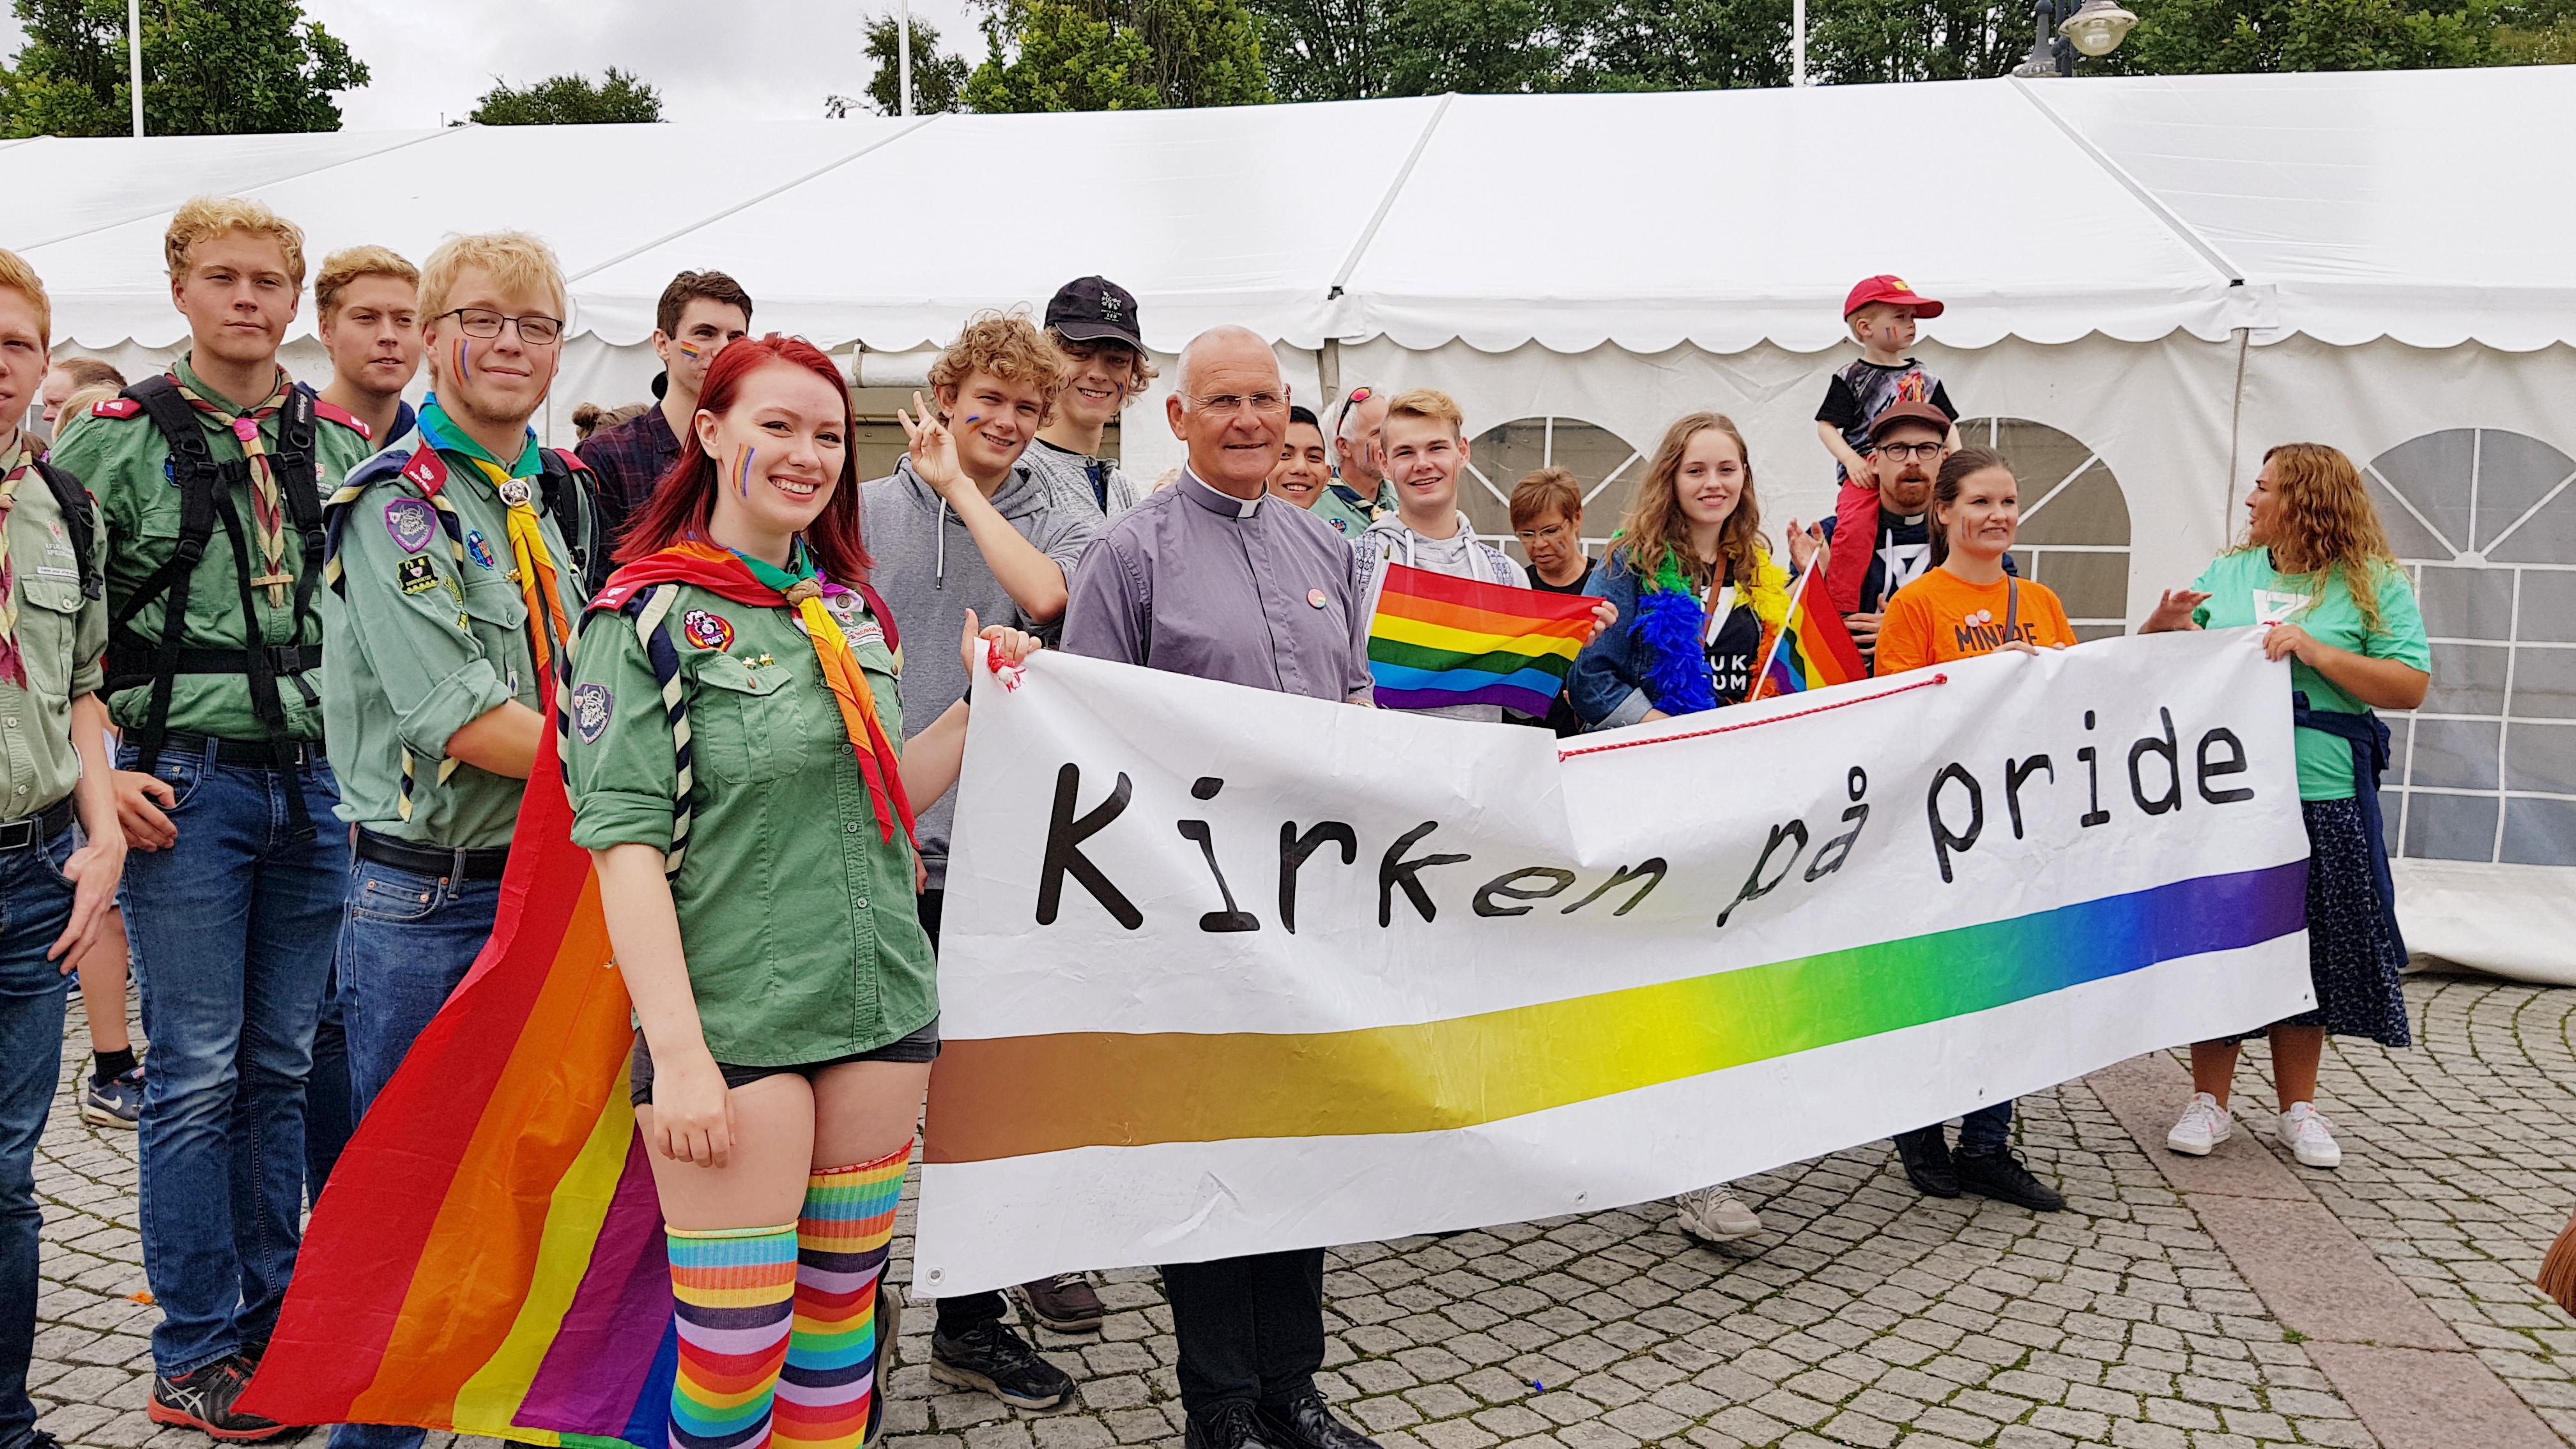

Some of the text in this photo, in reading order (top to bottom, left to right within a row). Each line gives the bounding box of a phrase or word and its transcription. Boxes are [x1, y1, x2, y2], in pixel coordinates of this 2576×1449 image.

[1702, 654, 1748, 671] UK
[1701, 673, 1747, 691] UM
[1036, 707, 2254, 935] Kirken på pride
